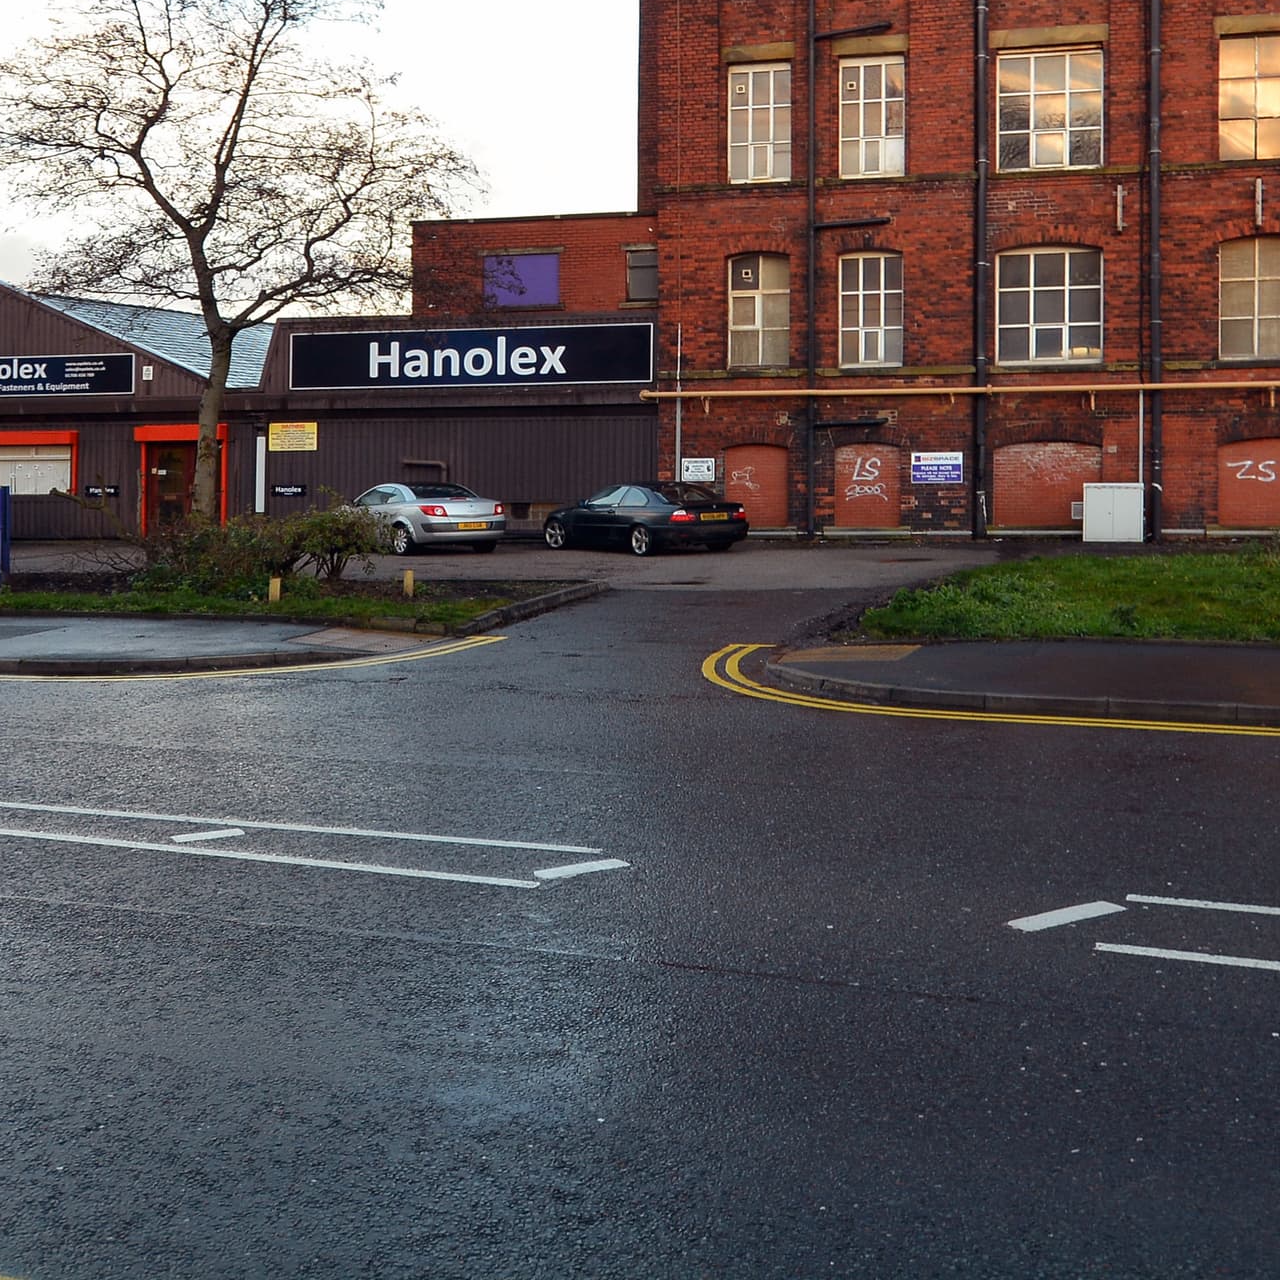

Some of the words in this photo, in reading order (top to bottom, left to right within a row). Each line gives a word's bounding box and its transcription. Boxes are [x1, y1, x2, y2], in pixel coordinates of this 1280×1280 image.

[369, 336, 567, 378] Hanolex
[36, 383, 44, 391] &
[45, 382, 90, 392] Equipment
